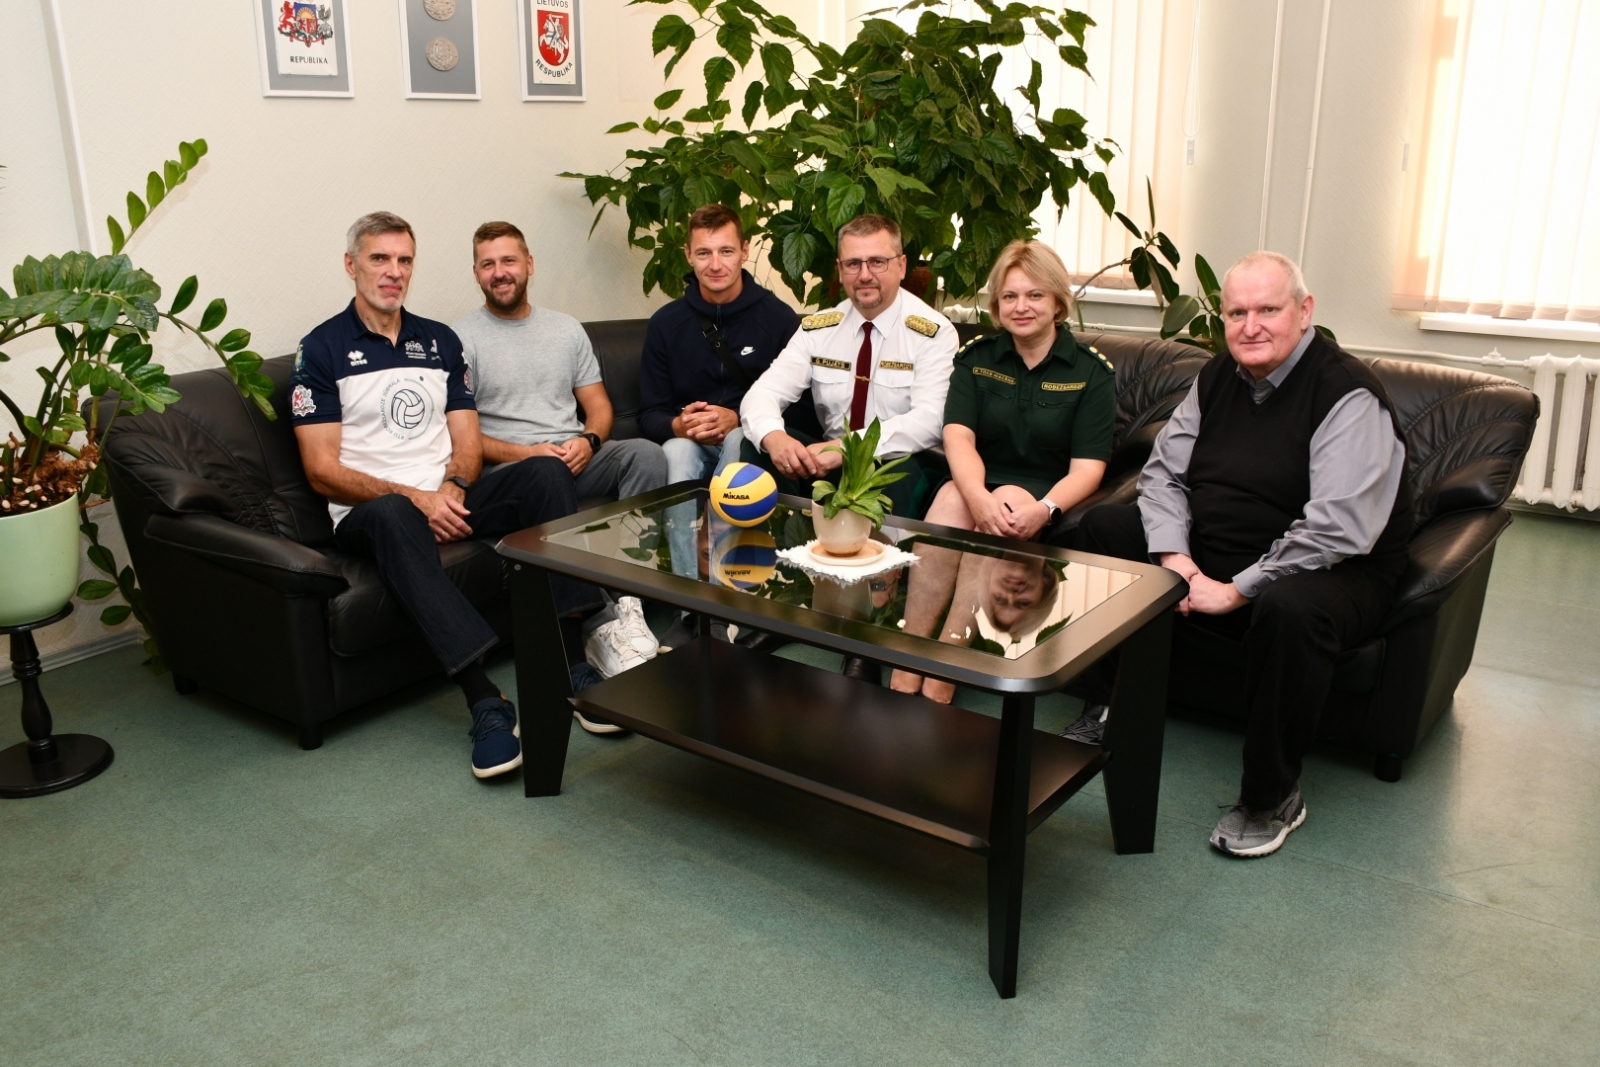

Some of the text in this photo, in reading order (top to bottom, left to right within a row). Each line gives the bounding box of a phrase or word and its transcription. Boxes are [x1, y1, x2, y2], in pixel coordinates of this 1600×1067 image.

[537, 0, 569, 8] LIETUVOS
[289, 55, 329, 65] REPUBLIKA
[535, 59, 573, 77] RESPUBLIKA
